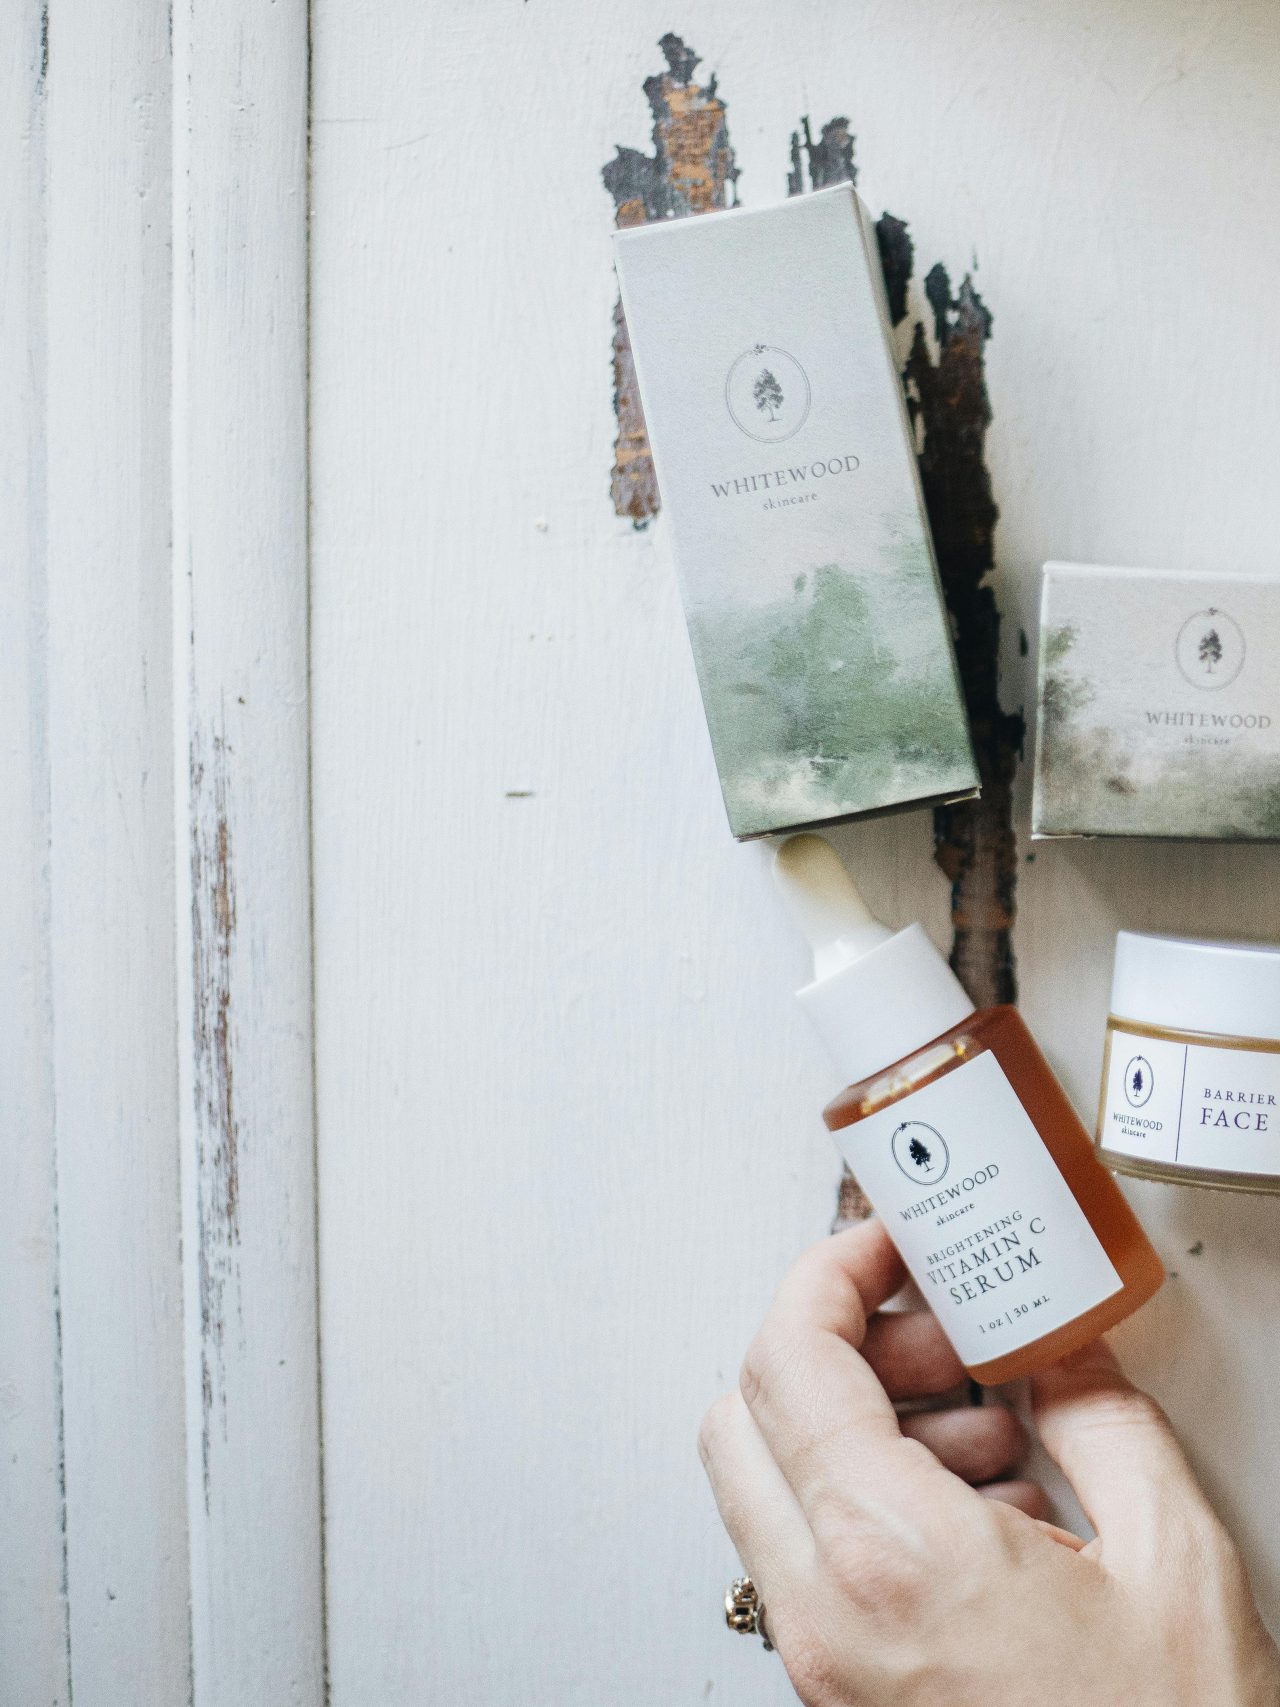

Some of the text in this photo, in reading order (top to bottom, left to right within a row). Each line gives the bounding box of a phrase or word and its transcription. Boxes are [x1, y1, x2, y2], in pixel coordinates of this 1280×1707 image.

[710, 455, 860, 498] WHITEWOOD
[762, 492, 818, 511] skincare
[1146, 711, 1271, 729] WHITEWOOD
[1203, 1088, 1277, 1106] BARRIER
[1112, 1112, 1163, 1131] WHITEWOOD
[1199, 1107, 1269, 1132] FACE
[1120, 1127, 1147, 1139] skincare
[899, 1164, 1000, 1222] WHITEWOOD
[936, 1202, 976, 1227] skincare
[926, 1210, 1024, 1266] BRIGHTENING
[926, 1217, 1046, 1286] VITAMIN C
[949, 1247, 1043, 1305] SERUM
[1013, 1303, 1029, 1318] 30
